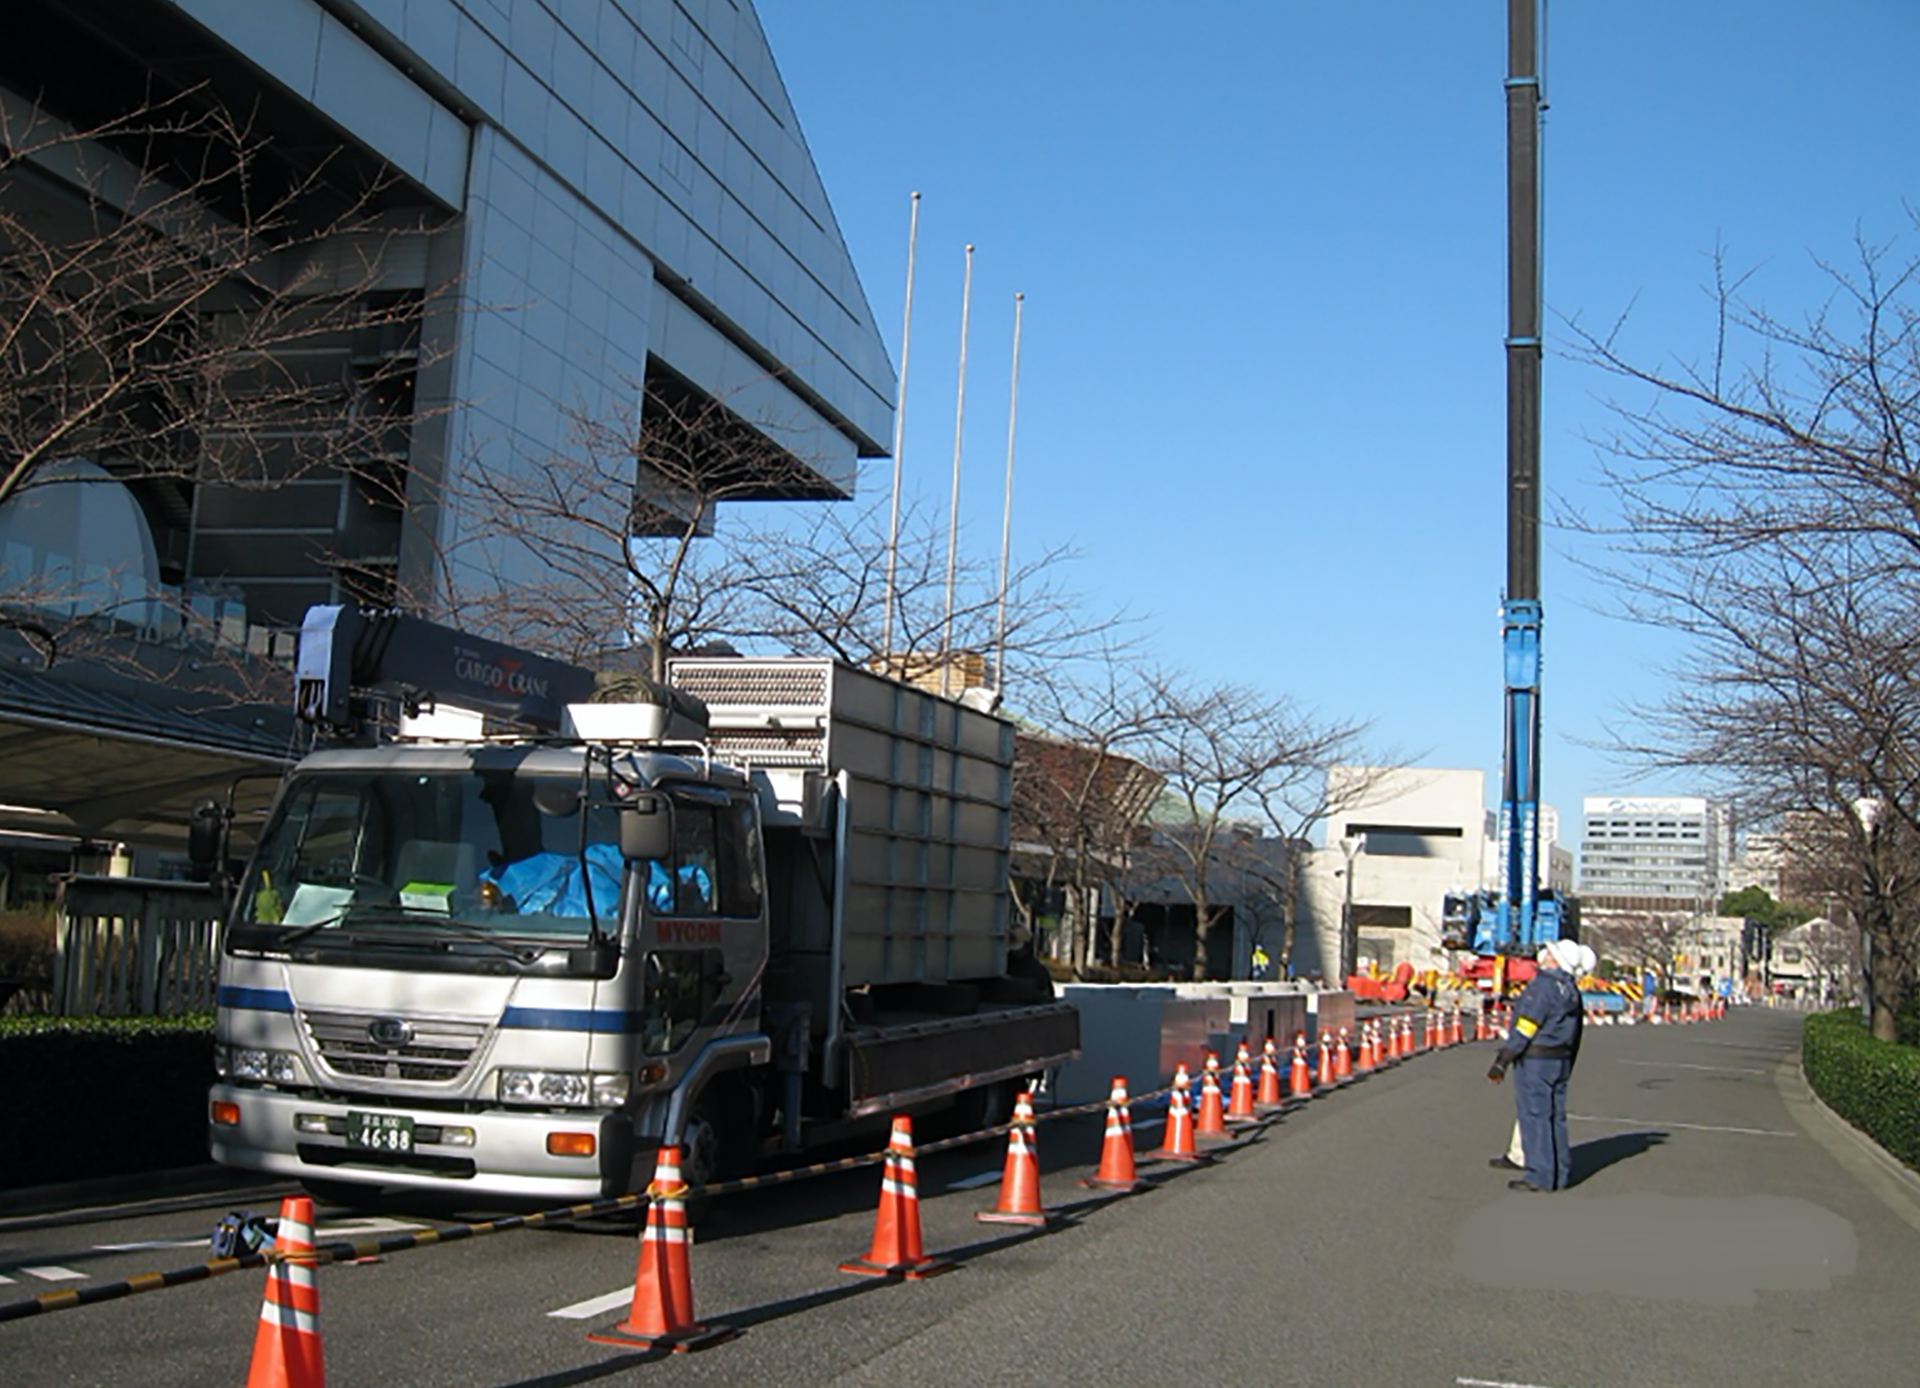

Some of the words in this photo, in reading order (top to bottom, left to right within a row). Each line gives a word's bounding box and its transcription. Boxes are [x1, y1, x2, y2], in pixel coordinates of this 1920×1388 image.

[454, 658, 502, 688] CARGO
[508, 670, 549, 699] CRANE
[657, 921, 721, 941] MYCOM
